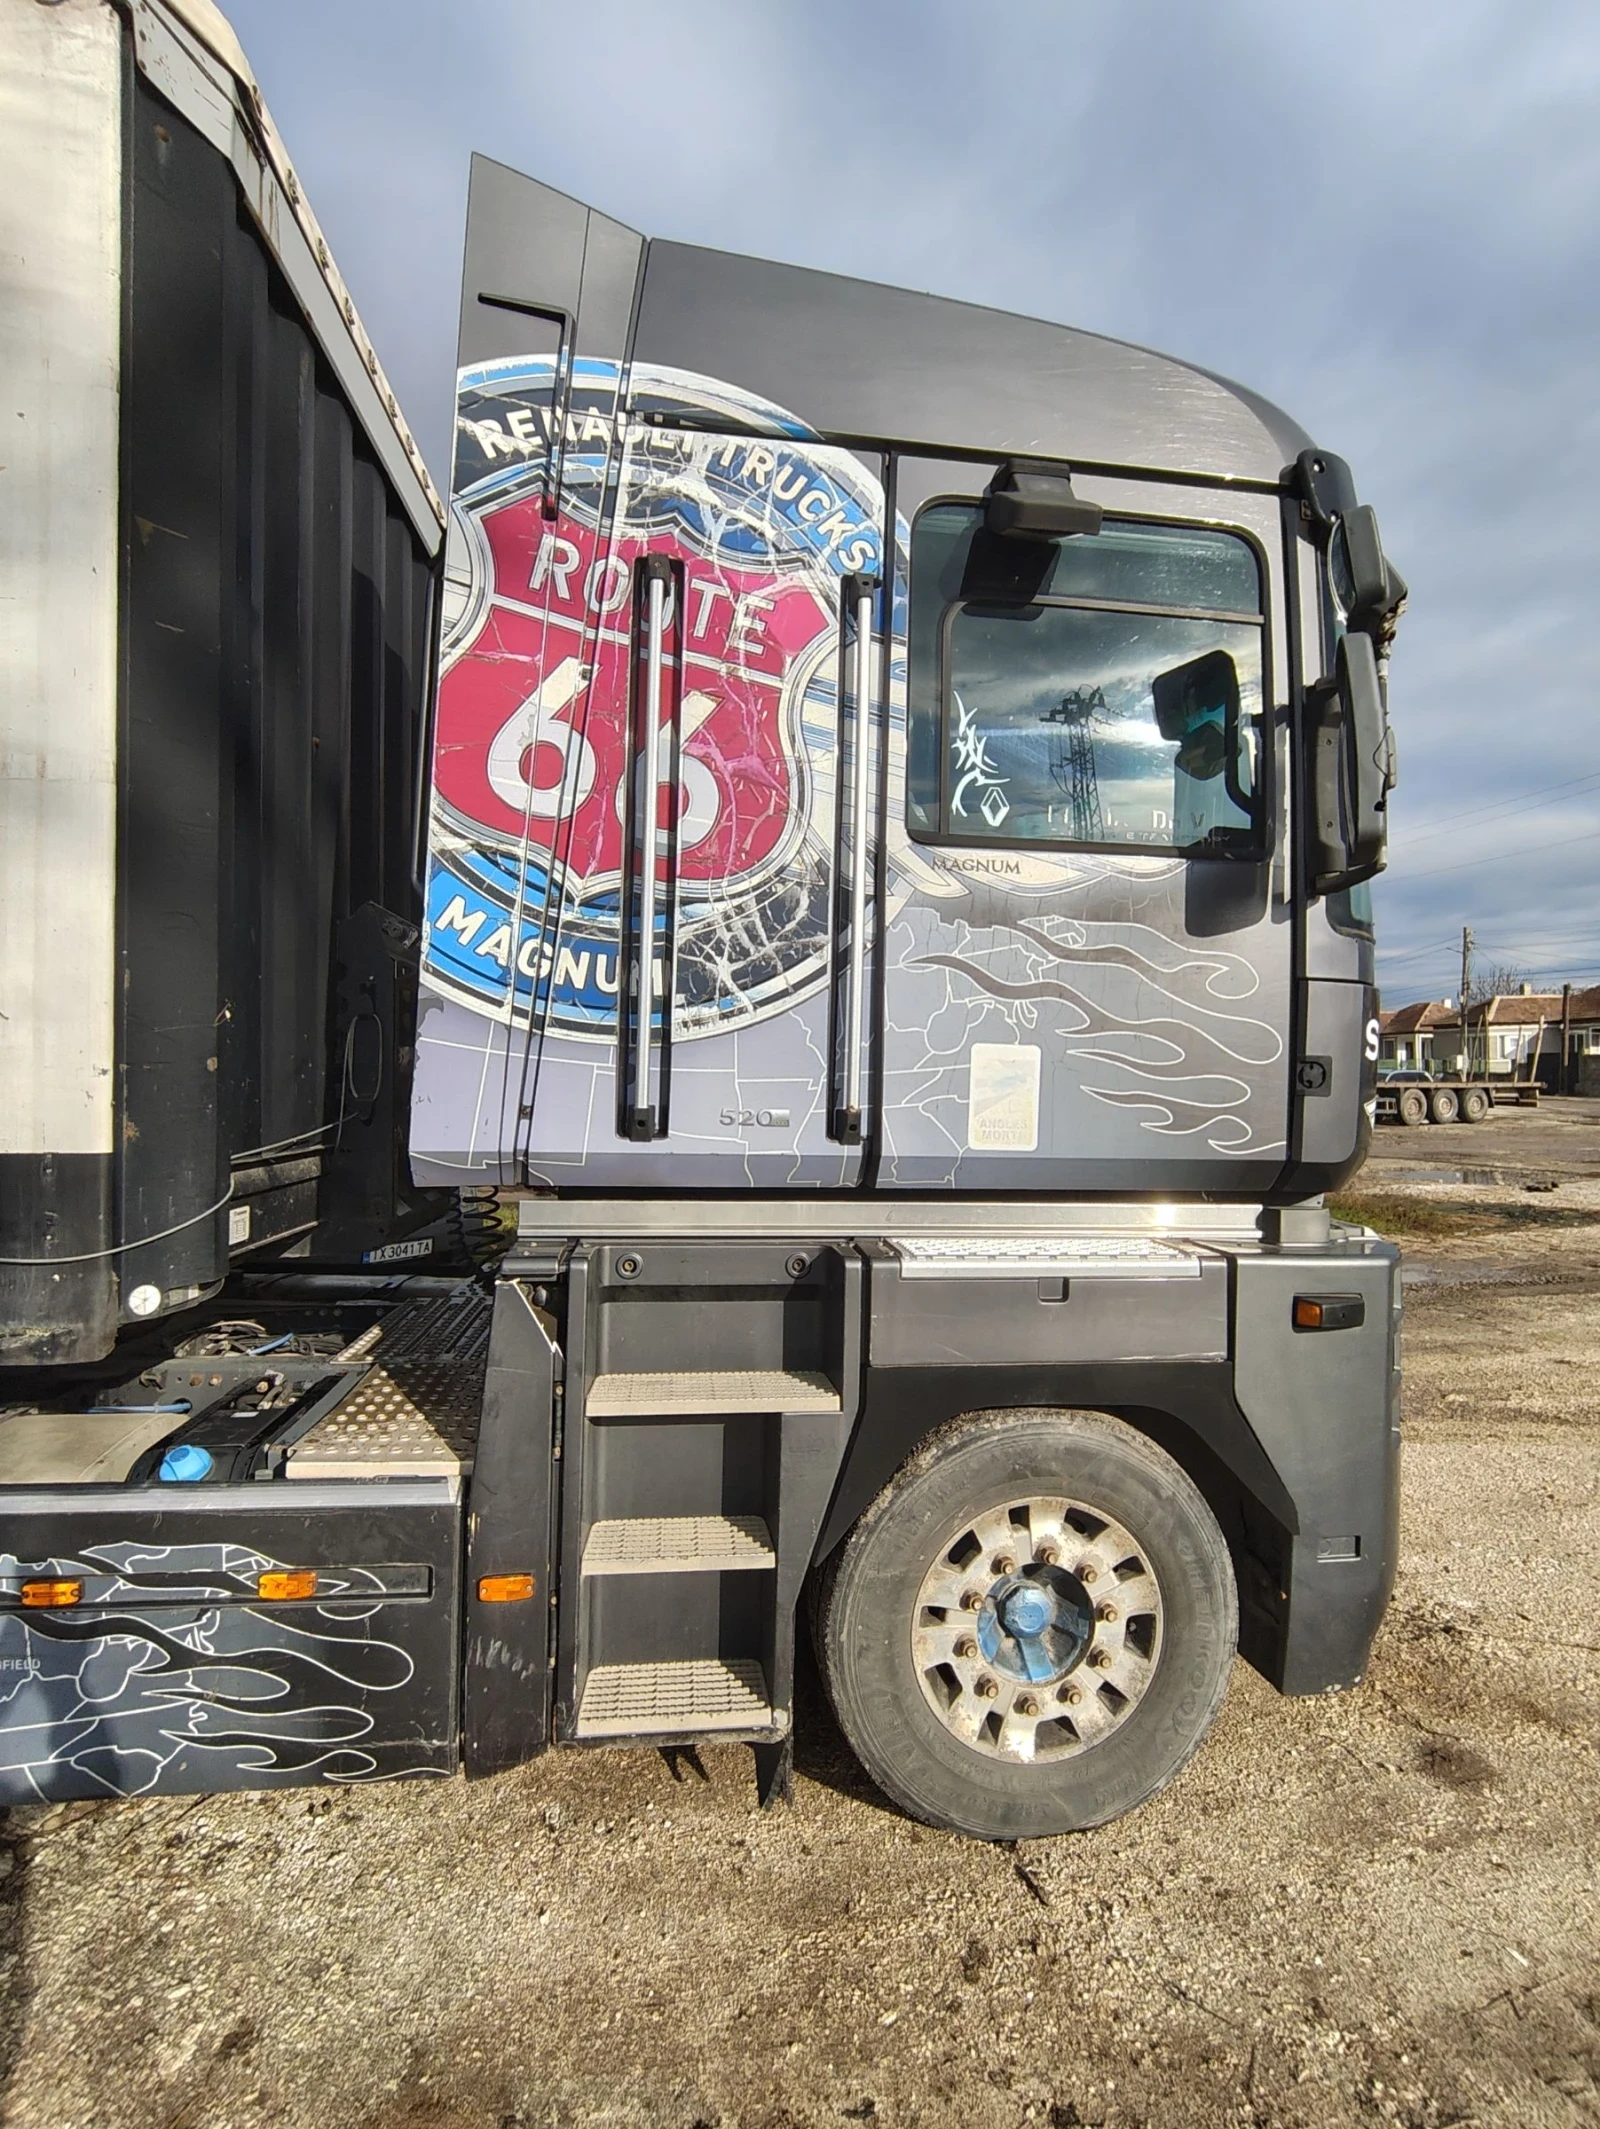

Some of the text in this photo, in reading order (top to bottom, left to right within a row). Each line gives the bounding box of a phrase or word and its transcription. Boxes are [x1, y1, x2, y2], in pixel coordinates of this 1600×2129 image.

[719, 439, 877, 571] TRUCKS
[486, 656, 725, 858] 66
[931, 857, 1021, 874] MAGNUM
[434, 894, 664, 997] MAGNUM
[719, 1108, 773, 1127] 520
[981, 1130, 1021, 1140] MORT
[0, 1659, 41, 1670] FIELD
